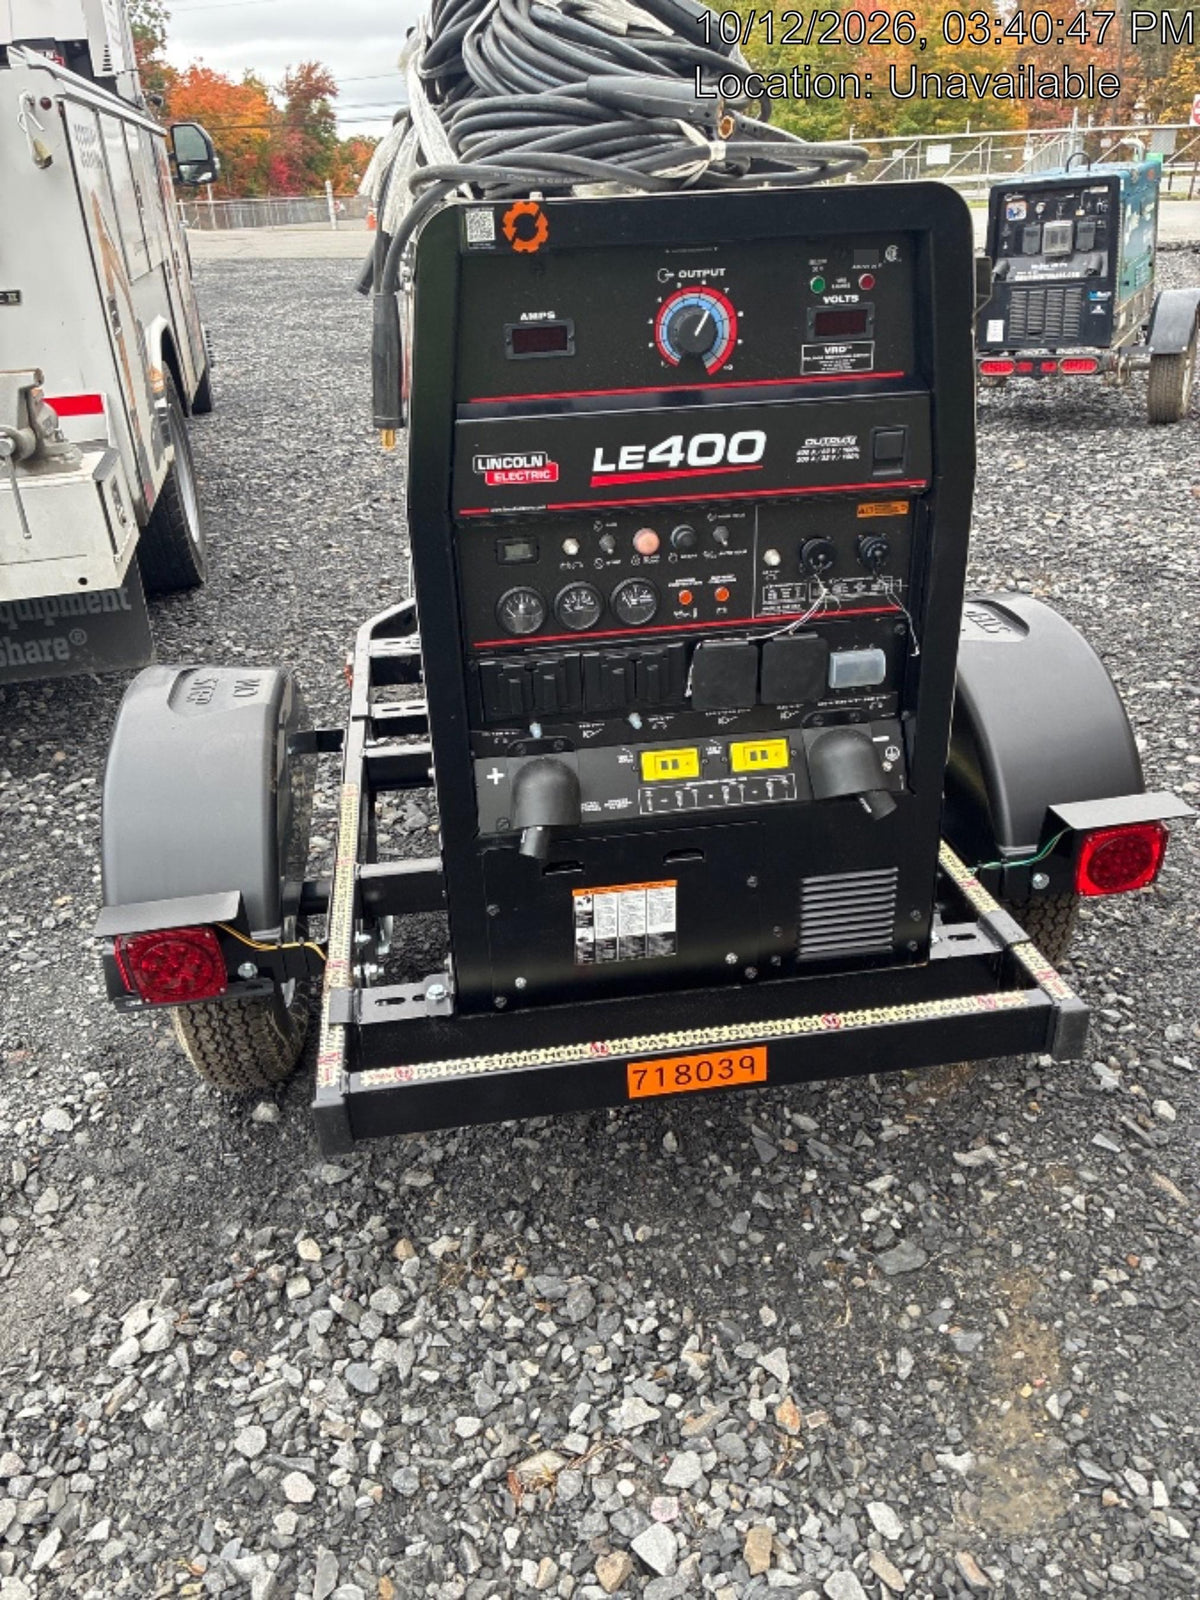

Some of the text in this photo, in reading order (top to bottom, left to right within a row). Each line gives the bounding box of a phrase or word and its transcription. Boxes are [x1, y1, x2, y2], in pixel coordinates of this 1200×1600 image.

[678, 267, 726, 278] OUTPUT
[823, 294, 859, 304] VOLTS
[520, 310, 556, 321] AMPS
[592, 430, 767, 472] LE400
[477, 455, 544, 471] LINCOLN
[494, 468, 551, 482] ELECTRIC
[0, 587, 132, 630] quipment
[416, 1066, 442, 1075] DO
[446, 1061, 479, 1072] NOT
[483, 1053, 540, 1067] STAND
[544, 1048, 587, 1060] HERE
[637, 1036, 670, 1048] PAS
[728, 1022, 793, 1036] DEBOUT
[632, 1054, 756, 1091] 718039
